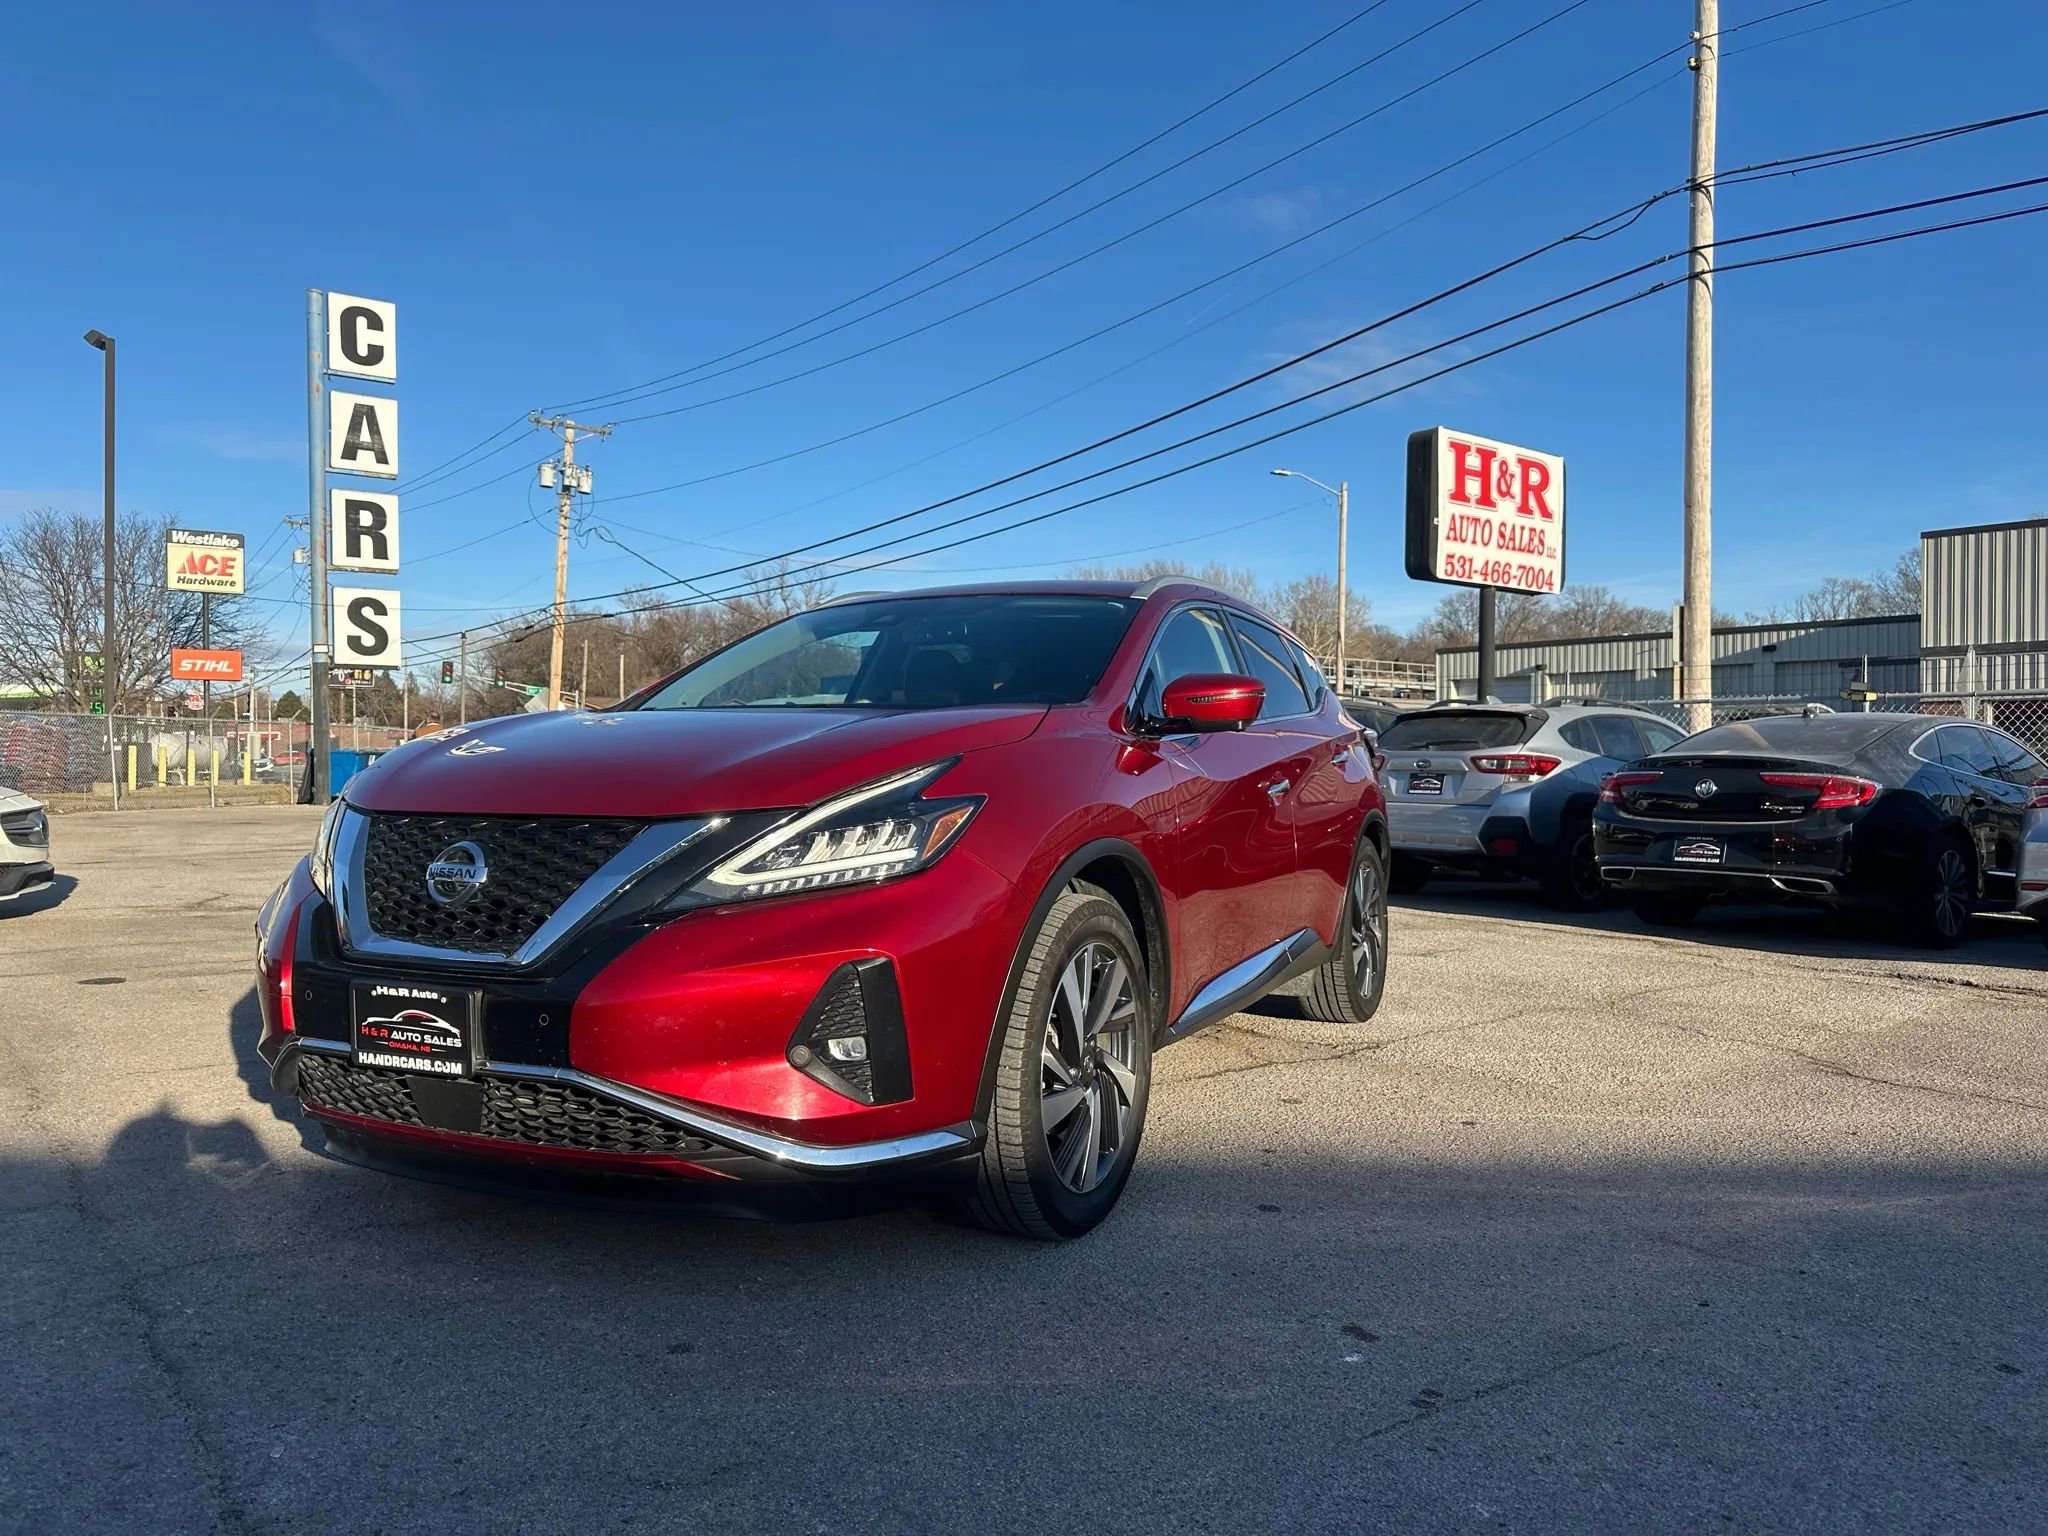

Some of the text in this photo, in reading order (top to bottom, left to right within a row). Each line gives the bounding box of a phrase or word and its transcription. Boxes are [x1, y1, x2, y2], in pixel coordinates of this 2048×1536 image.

[1448, 438, 1553, 522] H&R
[171, 530, 239, 548] Westlake
[1446, 513, 1493, 547] AUTO
[1497, 520, 1546, 557] SALES
[176, 551, 237, 577] ACE
[1444, 551, 1554, 591] 531-466-7004
[176, 575, 237, 588] Hardware
[178, 659, 234, 673] STIHL
[428, 866, 477, 880] NISSAN
[411, 989, 438, 999] Auto
[391, 1030, 421, 1042] AUTO
[423, 1034, 463, 1048] SALES
[421, 1044, 432, 1053] NE
[358, 1051, 463, 1075] HANDRCARS.COM
